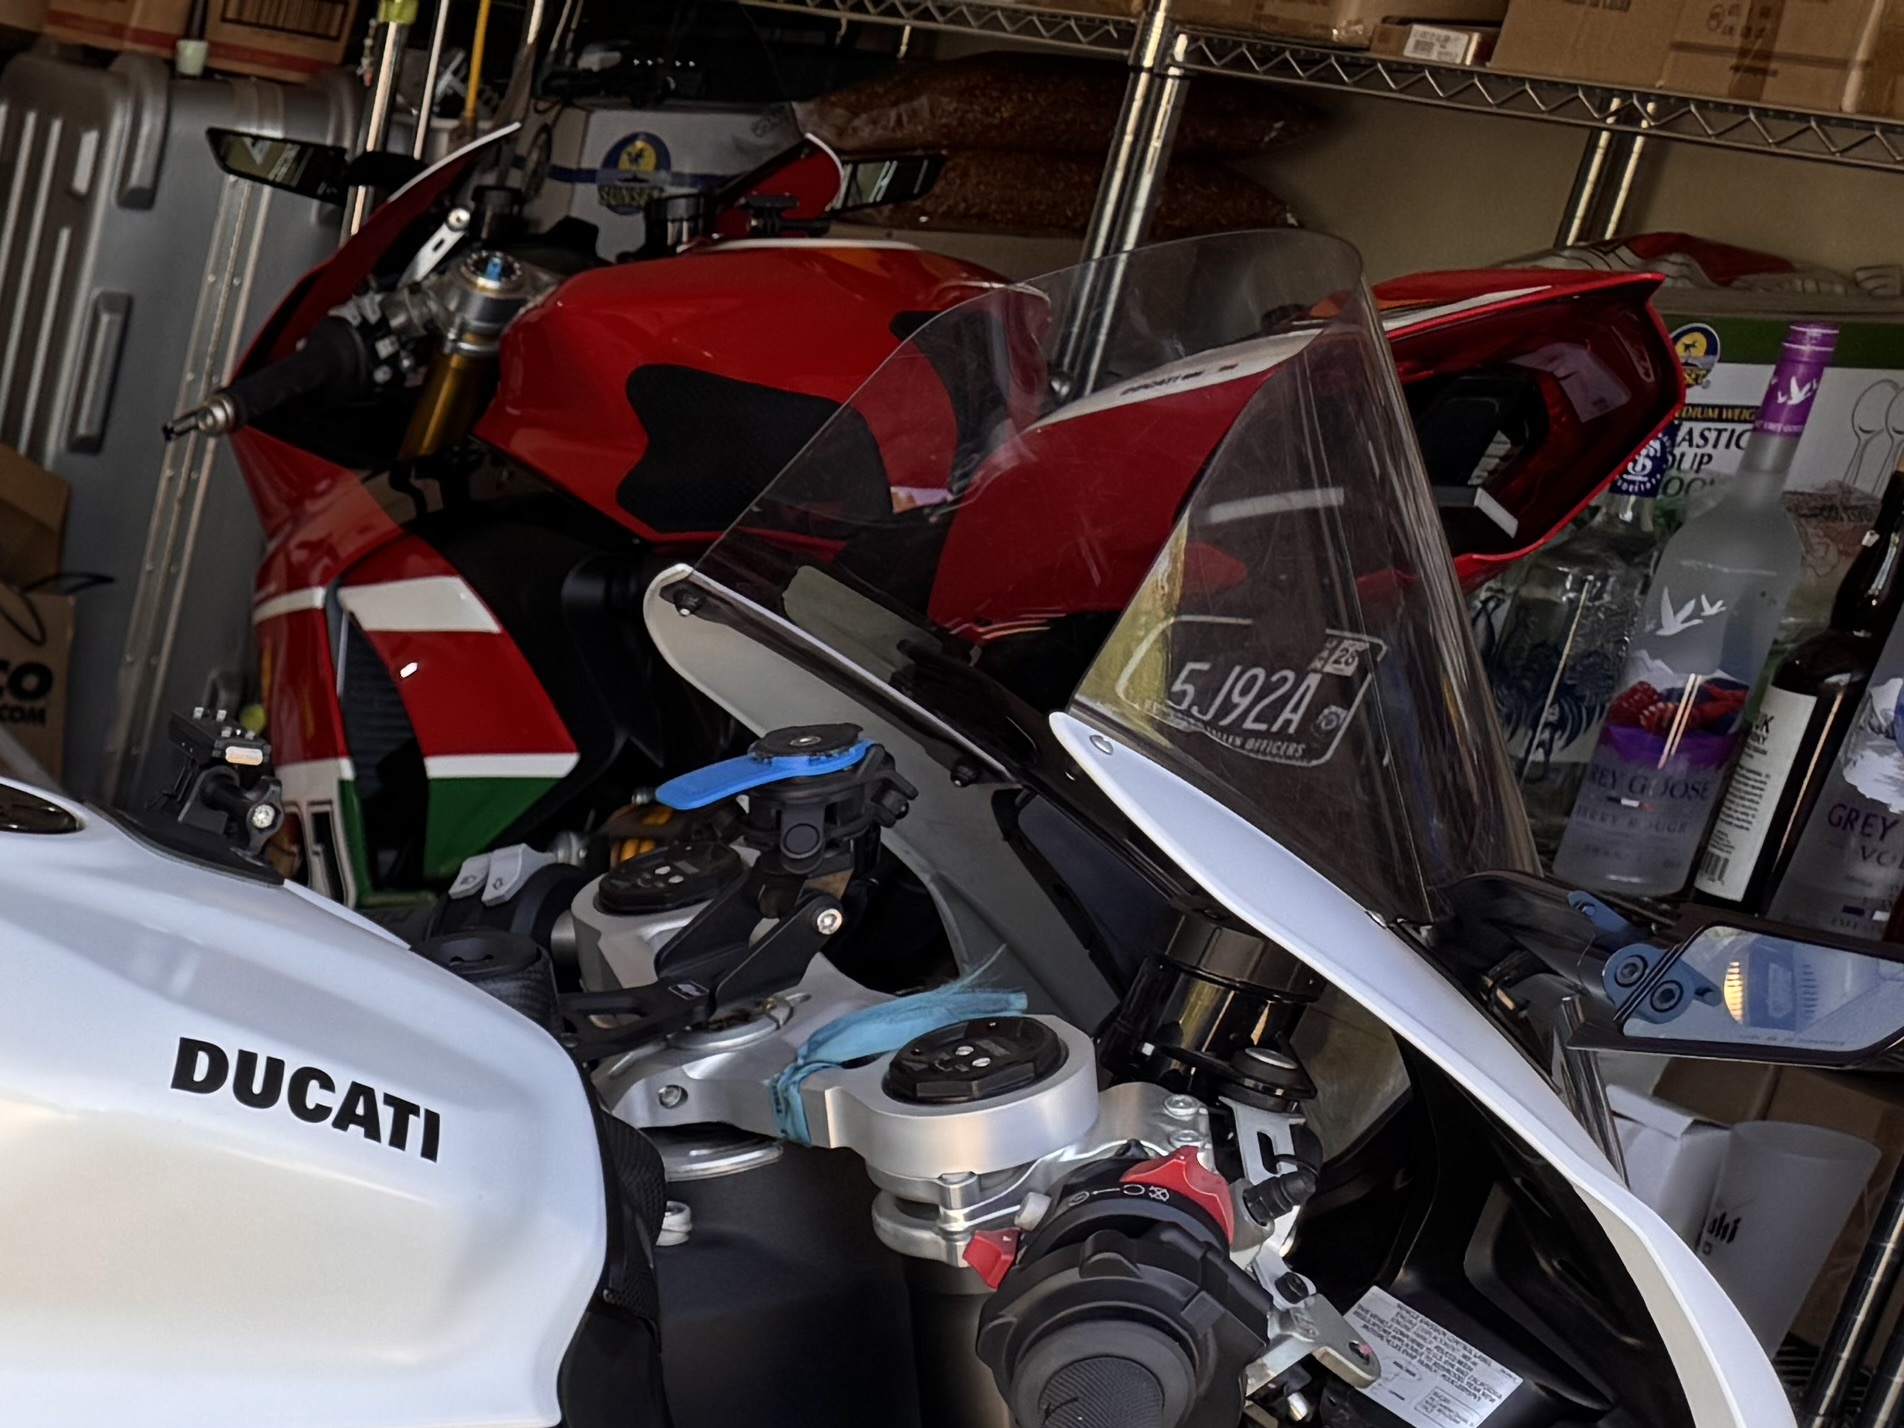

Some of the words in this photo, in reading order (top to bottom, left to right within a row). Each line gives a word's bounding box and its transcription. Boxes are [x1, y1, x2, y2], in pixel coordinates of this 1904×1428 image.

[1722, 408, 1759, 422] WEIG
[1827, 802, 1898, 842] GREY
[170, 1036, 441, 1164] DUCATI
